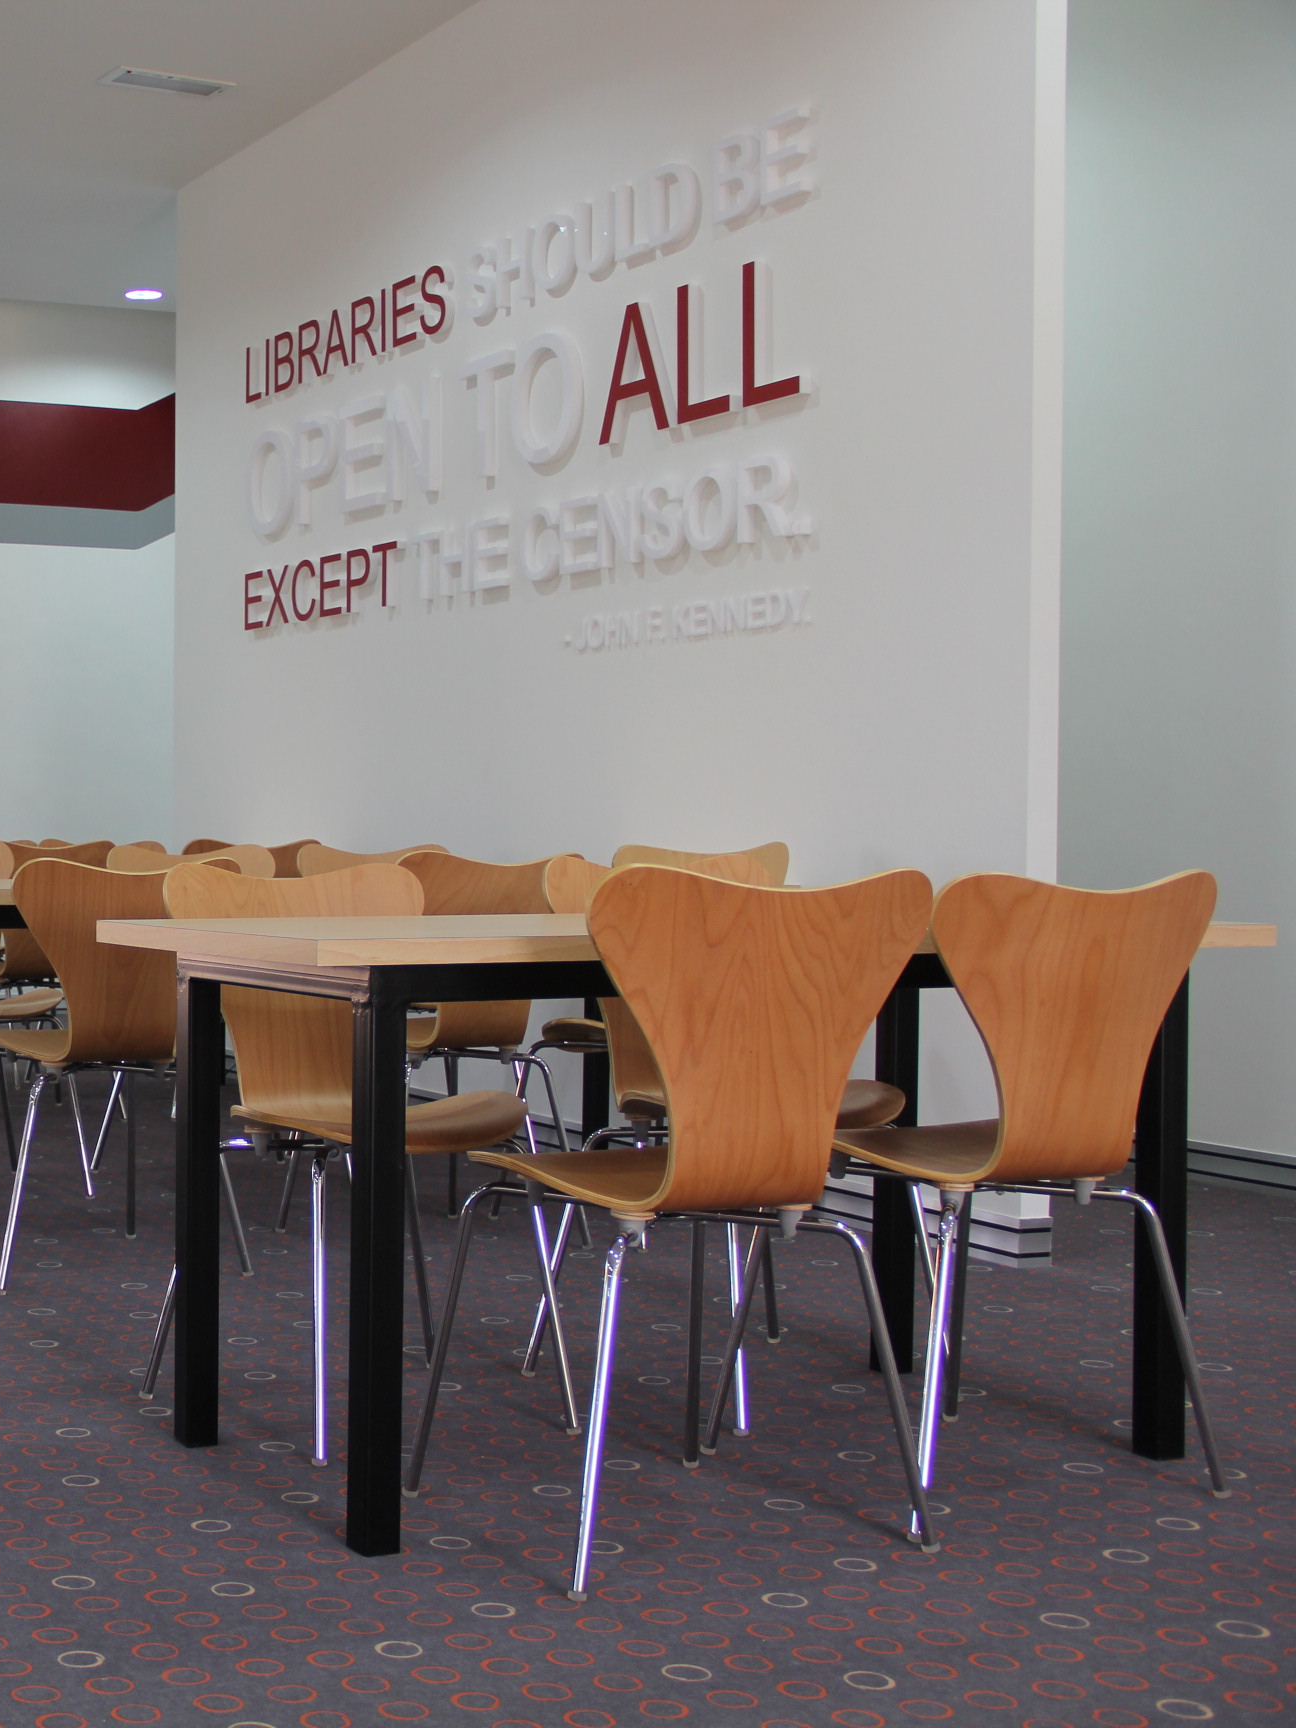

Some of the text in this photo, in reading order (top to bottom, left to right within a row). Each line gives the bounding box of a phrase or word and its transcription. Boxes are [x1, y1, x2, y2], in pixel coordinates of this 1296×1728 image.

[245, 104, 815, 404] LIBRARIES SHOULD BE
[245, 260, 808, 537] OPEN TO ALL
[244, 455, 812, 631] EXCEPT THE CENSOR.
[675, 586, 812, 640] KENNEDY.
